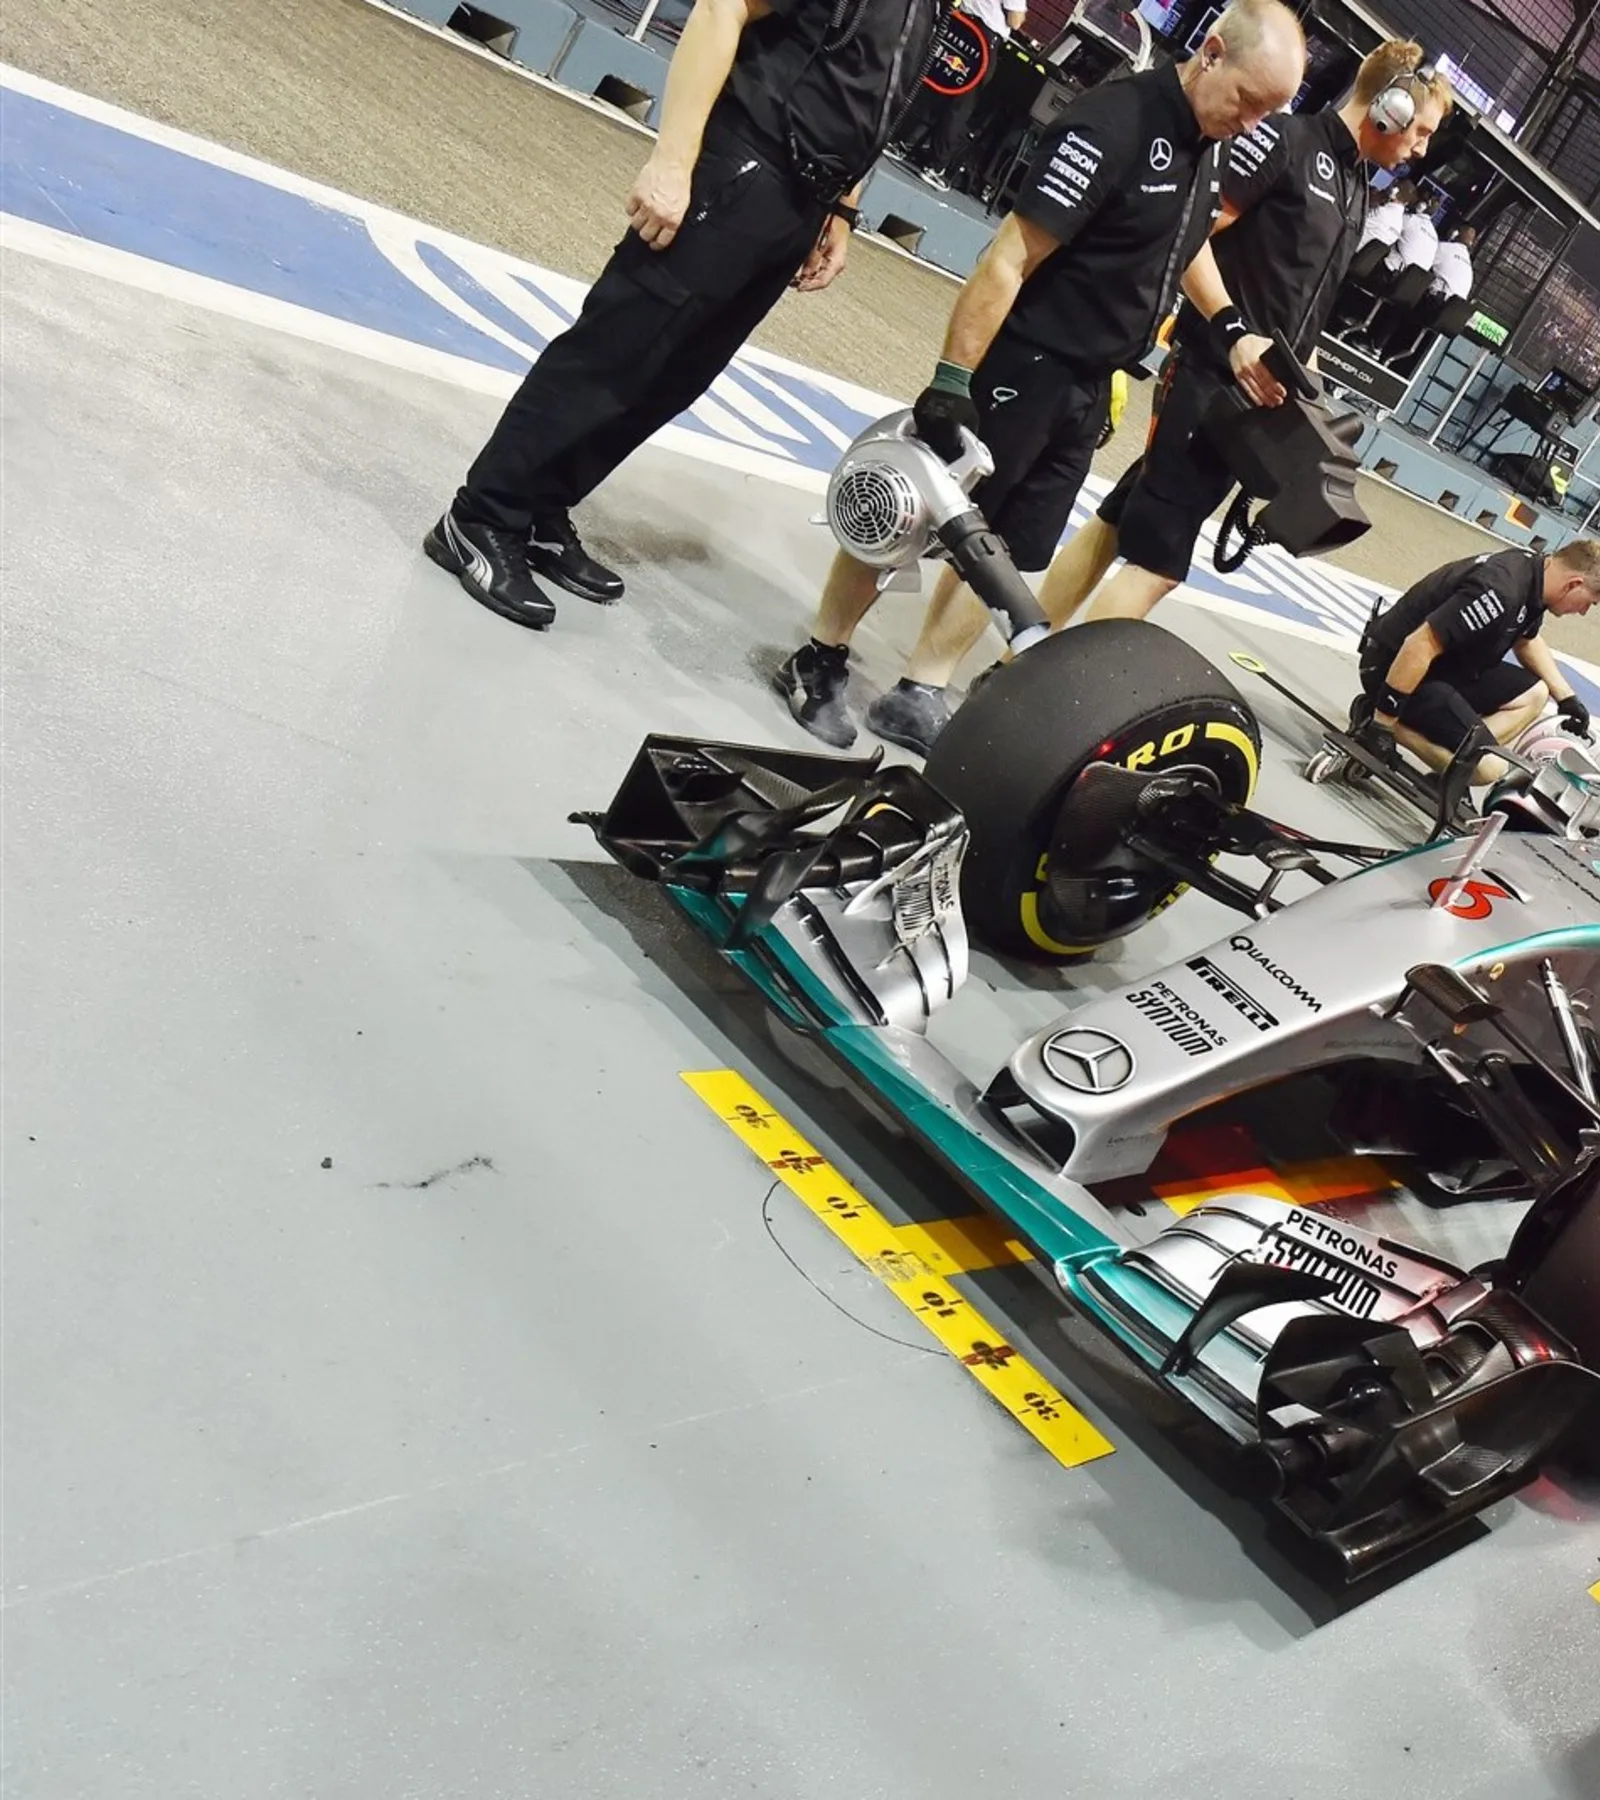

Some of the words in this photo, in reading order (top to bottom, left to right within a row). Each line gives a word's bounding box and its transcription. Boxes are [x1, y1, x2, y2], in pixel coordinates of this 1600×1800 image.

[1057, 142, 1098, 174] EPSON
[1251, 126, 1276, 152] SON
[1184, 955, 1281, 1033] PIRELLI
[1230, 935, 1323, 1014] QUALCOMM
[1125, 990, 1214, 1057] SYNTIUM
[1151, 981, 1228, 1047] PETRONAS
[1286, 1209, 1398, 1279] PETRONAS
